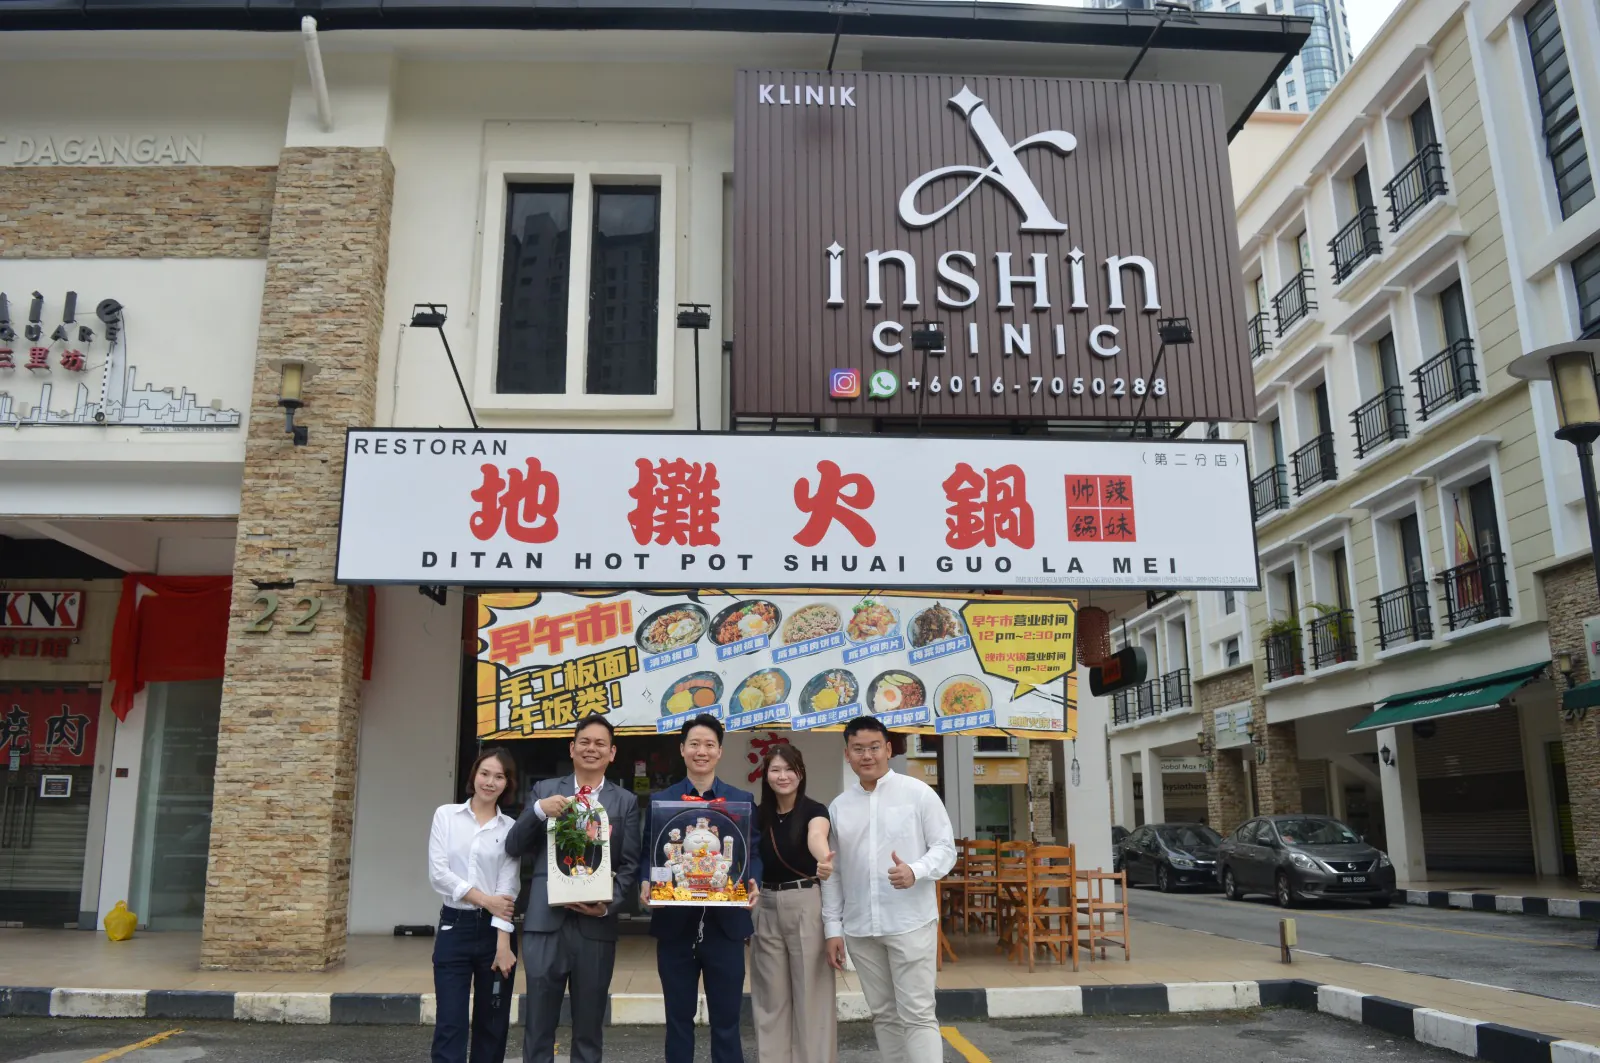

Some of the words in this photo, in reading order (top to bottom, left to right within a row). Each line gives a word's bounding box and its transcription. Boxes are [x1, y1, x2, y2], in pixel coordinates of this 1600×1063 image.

[759, 83, 857, 108] KLINIK
[13, 134, 204, 165] DAGANGAN
[354, 437, 508, 456] RESTORAN
[421, 551, 544, 569] DITAN
[574, 553, 650, 570] HOT
[681, 553, 752, 571] POT
[784, 554, 906, 572] SHUAI
[936, 555, 1013, 573] GUO
[1042, 556, 1084, 574] LA
[1113, 557, 1177, 574] MEI
[242, 589, 322, 632] 22
[971, 613, 1069, 628] 早午市营业时间
[488, 599, 635, 667] 早午市!
